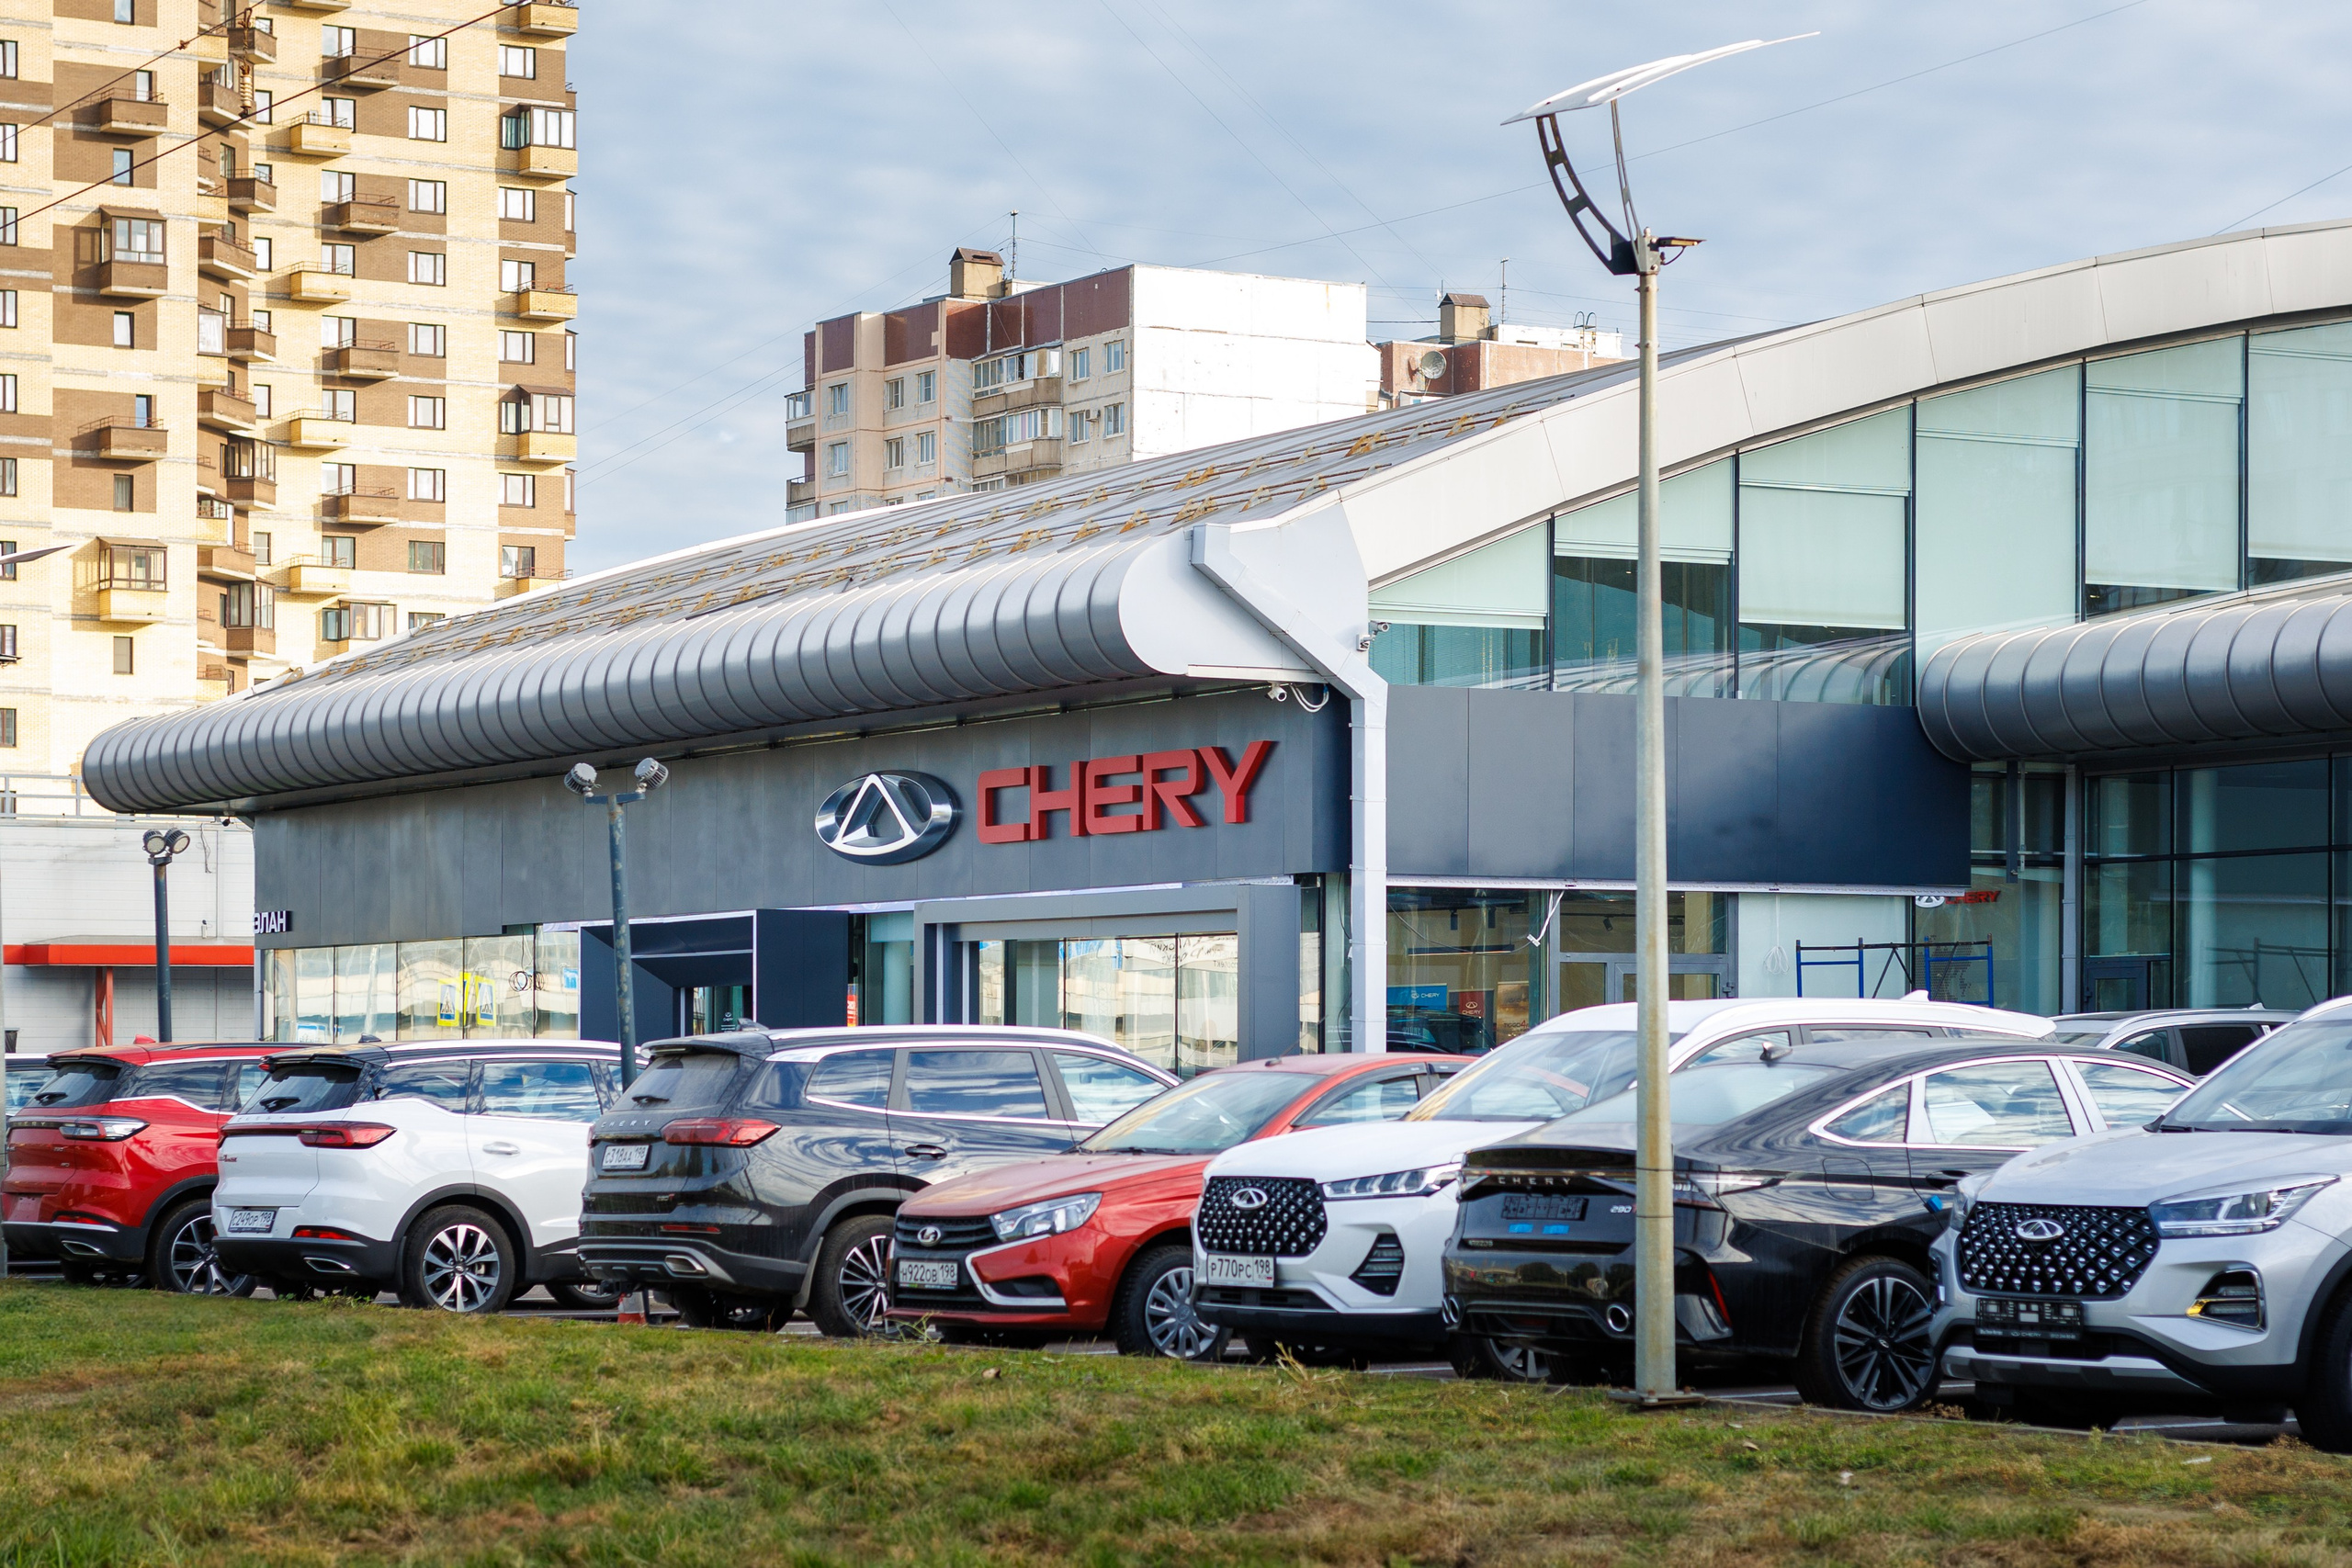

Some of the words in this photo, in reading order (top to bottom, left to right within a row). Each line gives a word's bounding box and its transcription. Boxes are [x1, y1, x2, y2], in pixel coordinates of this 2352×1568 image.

[977, 739, 1279, 844] CHERY
[253, 909, 287, 934] ЭЛАН
[601, 1120, 651, 1129] CHERY
[1498, 1177, 1571, 1186] CHERY
